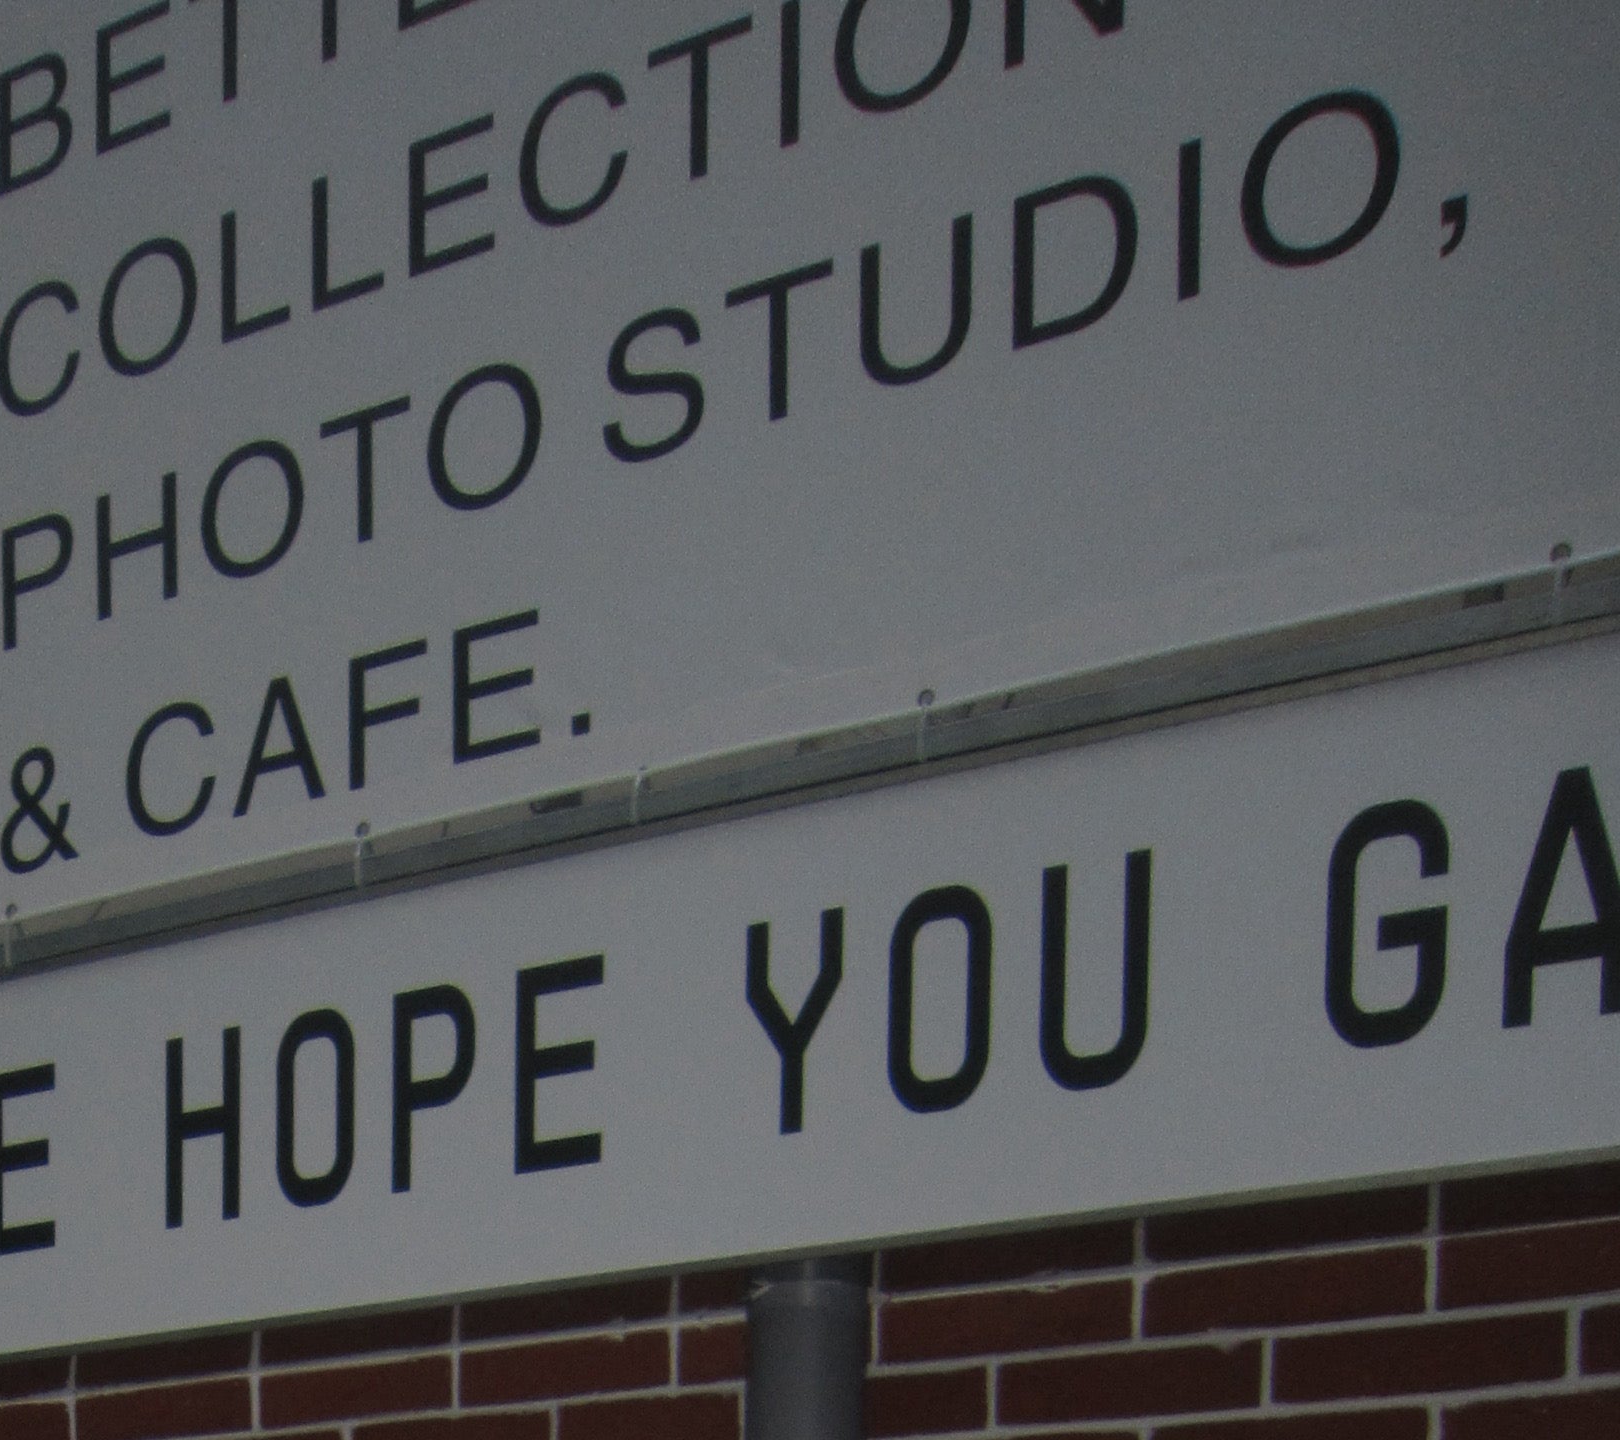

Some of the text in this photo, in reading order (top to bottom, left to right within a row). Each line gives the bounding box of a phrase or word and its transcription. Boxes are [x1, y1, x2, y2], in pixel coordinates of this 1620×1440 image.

[1, 89, 1470, 651] PHOTO STUDIO,
[0, 609, 594, 874] & CAFE.
[166, 954, 604, 1229] HOPE
[745, 849, 1152, 1134] YOU
[1324, 766, 1620, 1049] GA
